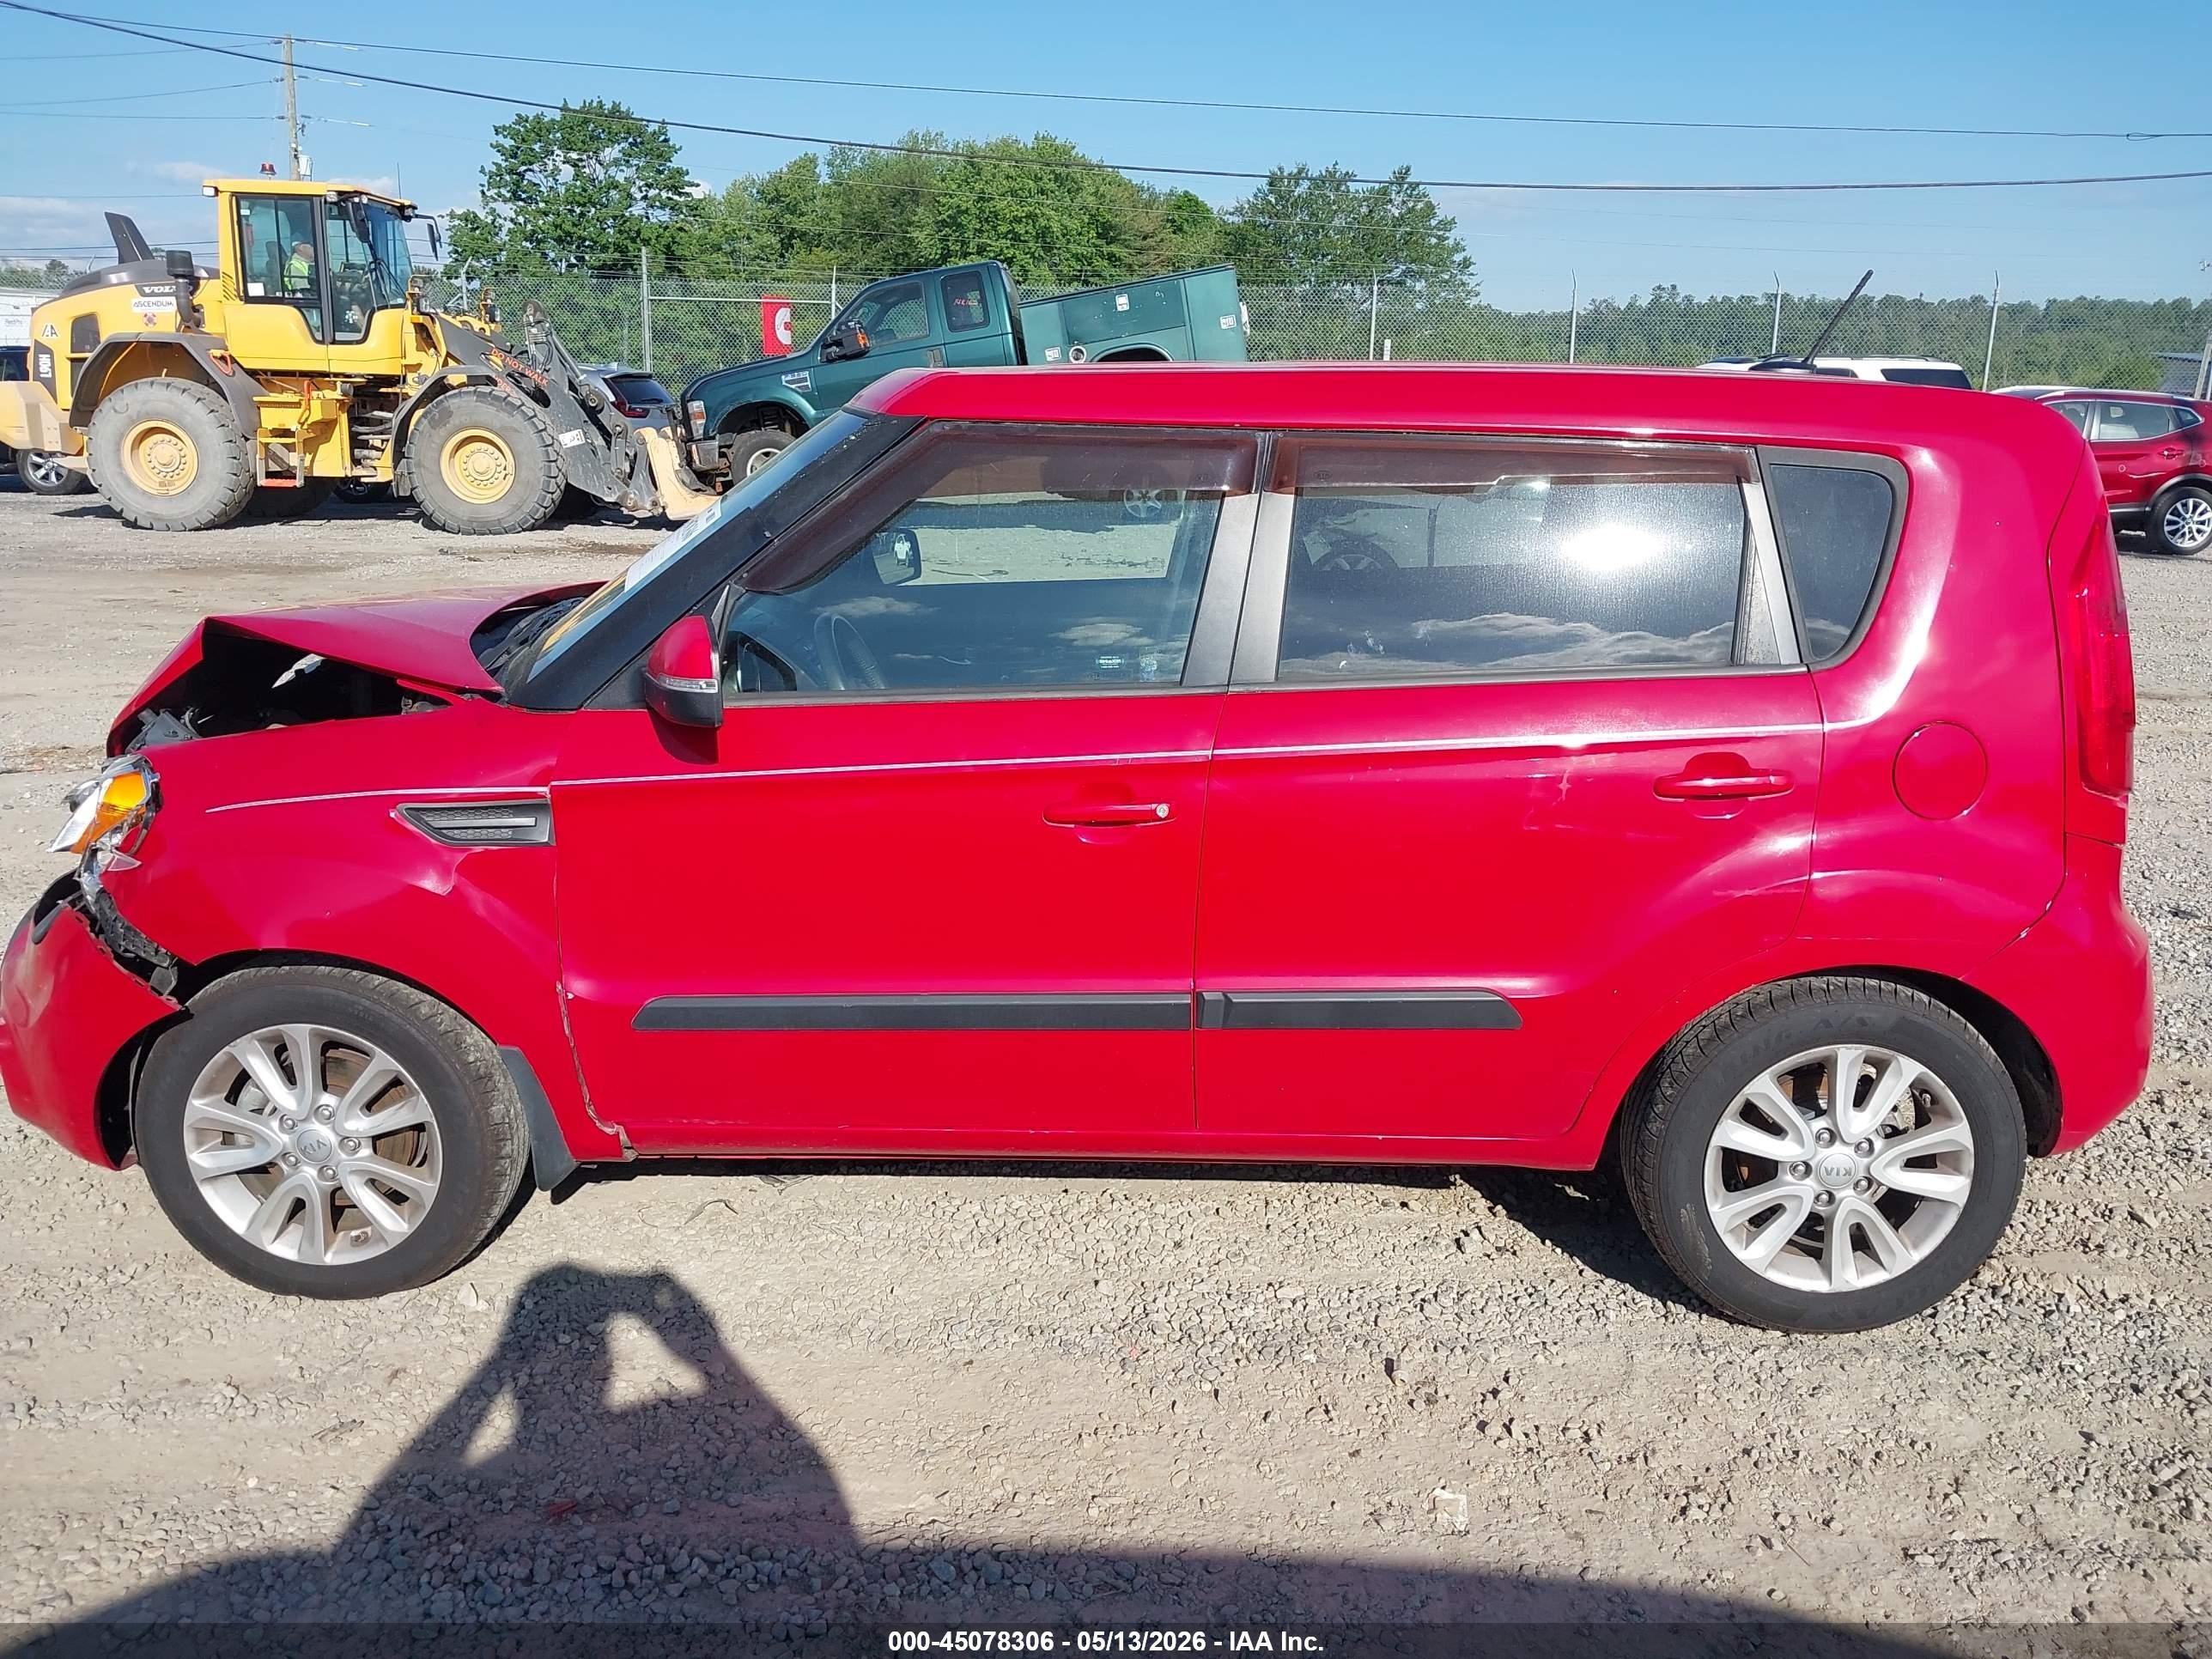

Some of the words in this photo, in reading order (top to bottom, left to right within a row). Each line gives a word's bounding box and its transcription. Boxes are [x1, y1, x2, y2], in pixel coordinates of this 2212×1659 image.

[38, 354, 52, 379] L90H
[491, 349, 505, 360] DO
[505, 356, 523, 371] NOT
[525, 368, 549, 386] WALK
[300, 1139, 327, 1156] KIA
[1823, 1166, 1852, 1176] KIA
